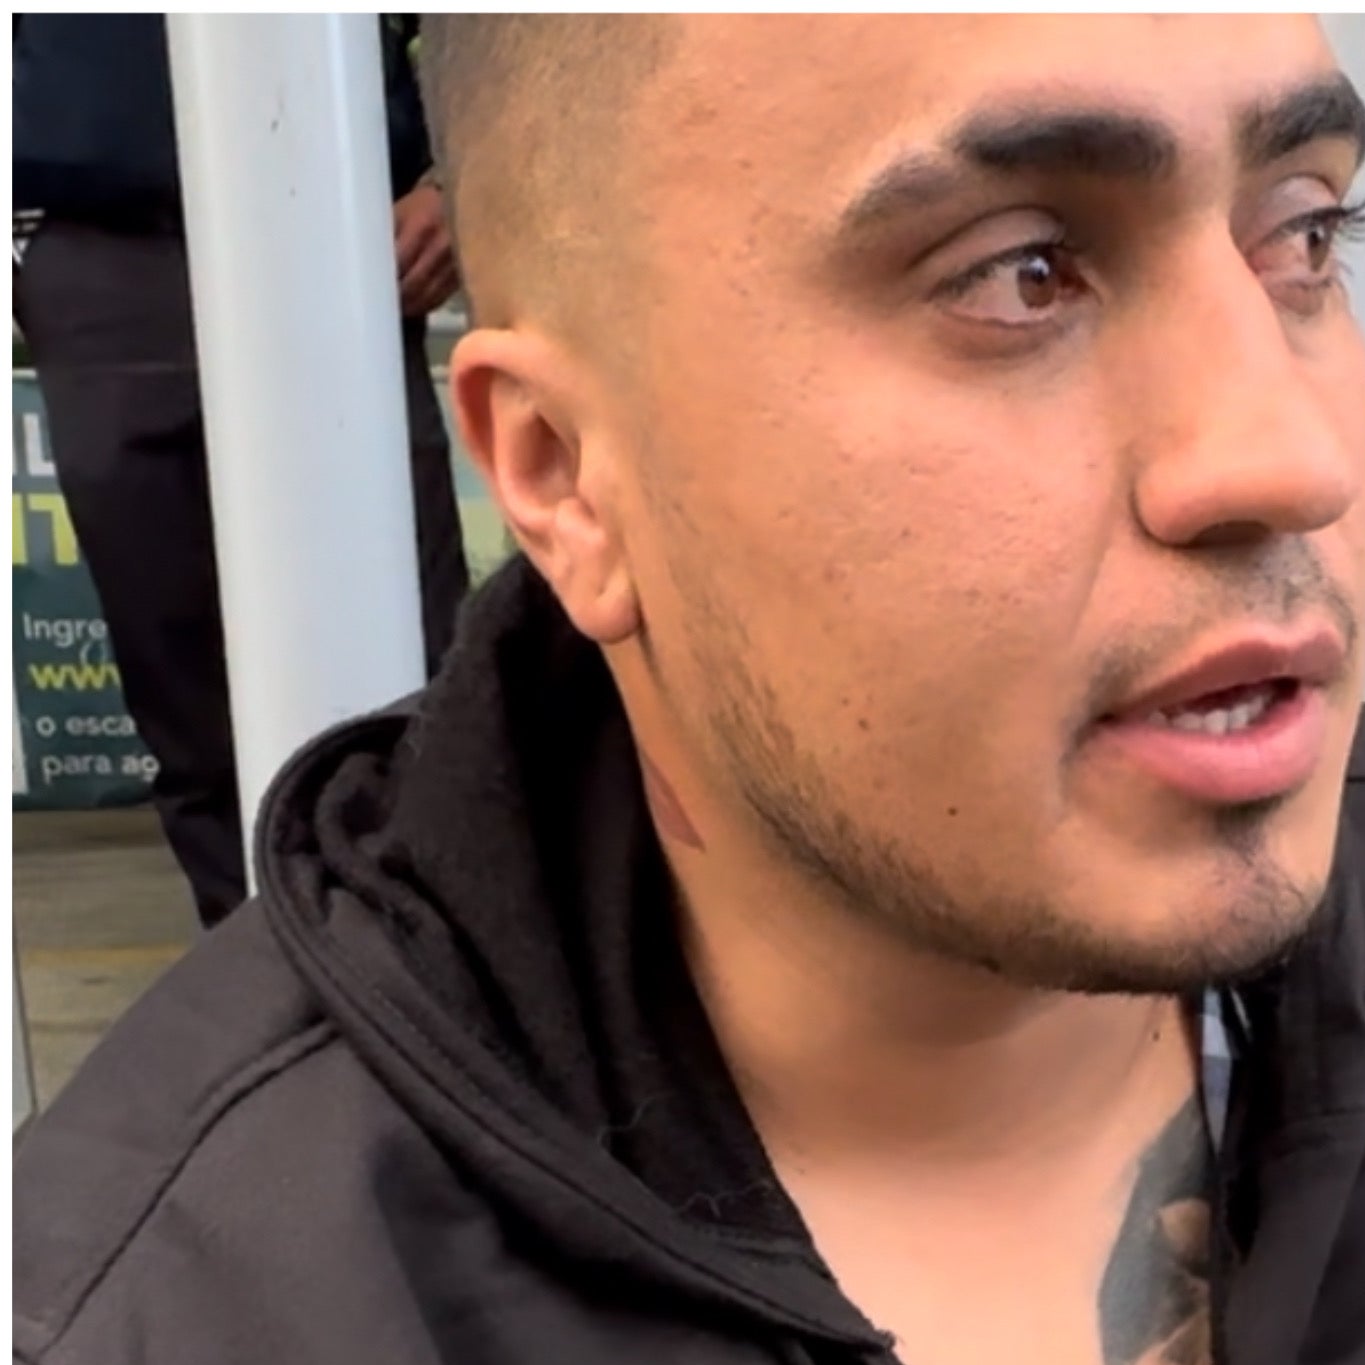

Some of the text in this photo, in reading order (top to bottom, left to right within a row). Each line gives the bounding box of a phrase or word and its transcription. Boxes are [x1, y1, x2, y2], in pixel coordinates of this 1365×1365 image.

[22, 612, 108, 648] Ingre
[35, 714, 137, 738] o esca
[42, 754, 112, 785] para
